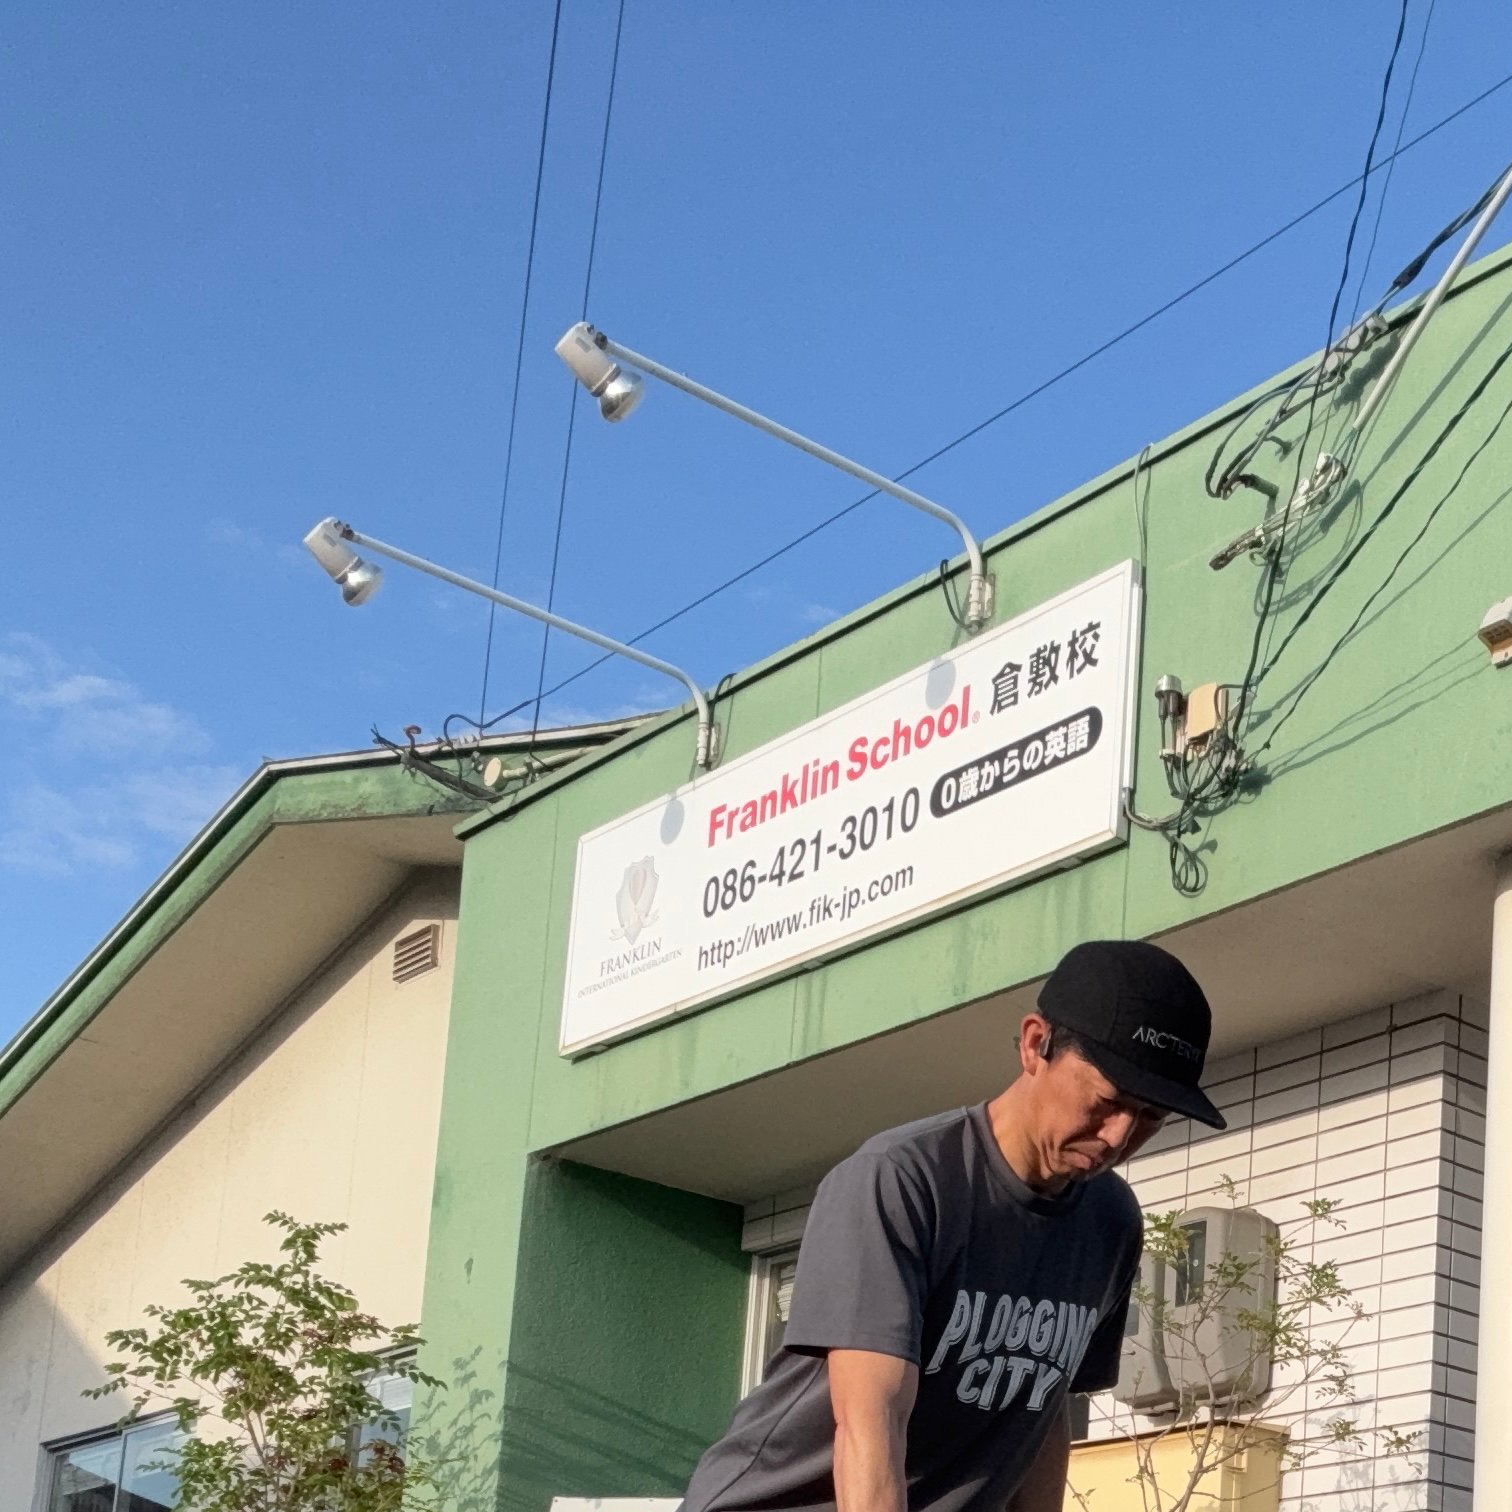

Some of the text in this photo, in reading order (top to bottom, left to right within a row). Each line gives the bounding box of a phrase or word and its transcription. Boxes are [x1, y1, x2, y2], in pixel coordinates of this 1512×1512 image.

[708, 620, 1102, 849] Franklin School 倉敷校
[940, 715, 1091, 811] 0歳からの英語
[702, 786, 921, 919] 086-421-3010
[599, 937, 662, 977] FRANKLIN
[697, 864, 914, 972] http://www.fik-jp.com
[955, 1355, 1064, 1412] CITY
